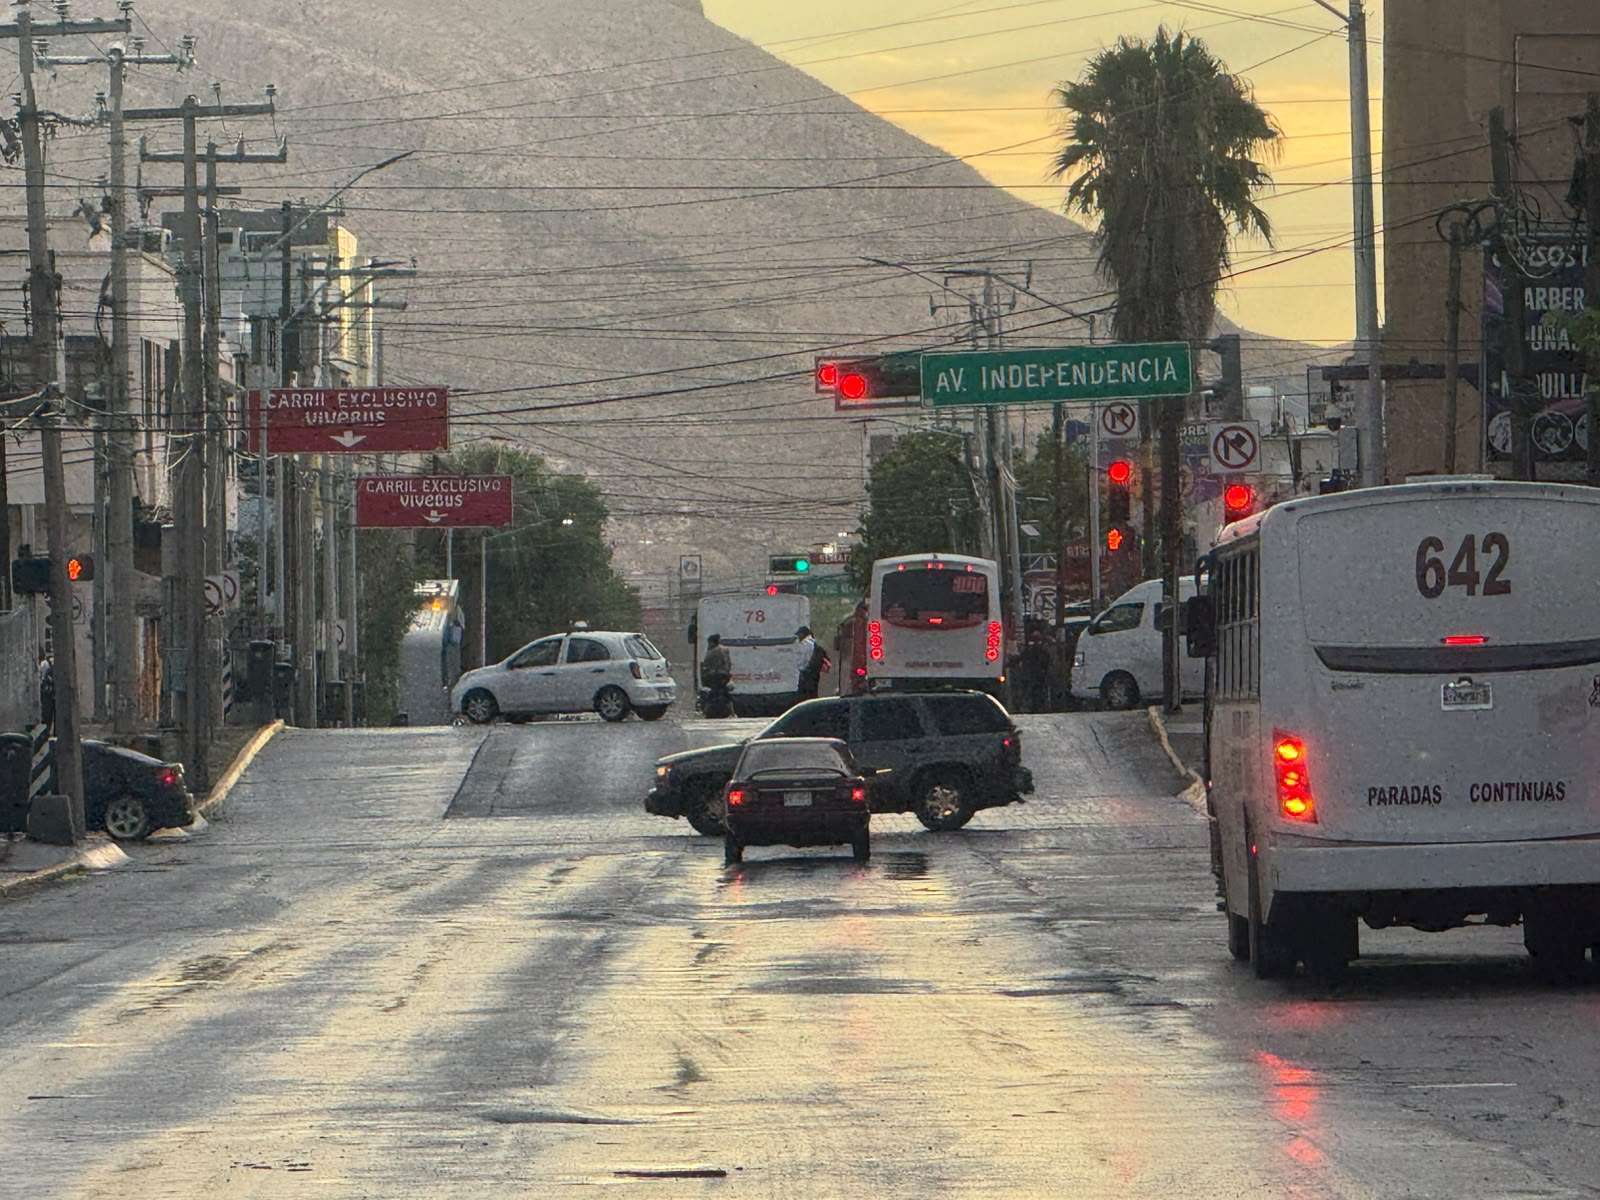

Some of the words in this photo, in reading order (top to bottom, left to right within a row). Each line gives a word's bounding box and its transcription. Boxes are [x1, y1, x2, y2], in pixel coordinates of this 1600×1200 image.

[1524, 287, 1585, 311] ARBER
[936, 367, 968, 393] AV.
[980, 357, 1178, 390] INDEPENDENCIA
[337, 391, 437, 408] EXCLUSIVO
[366, 480, 417, 493] CARRIL
[422, 479, 501, 493] EXCLUSIVO
[1415, 531, 1512, 600] 642
[744, 609, 766, 624] 78
[1367, 784, 1442, 807] PARADAS
[1469, 780, 1567, 803] CONTINUAS
